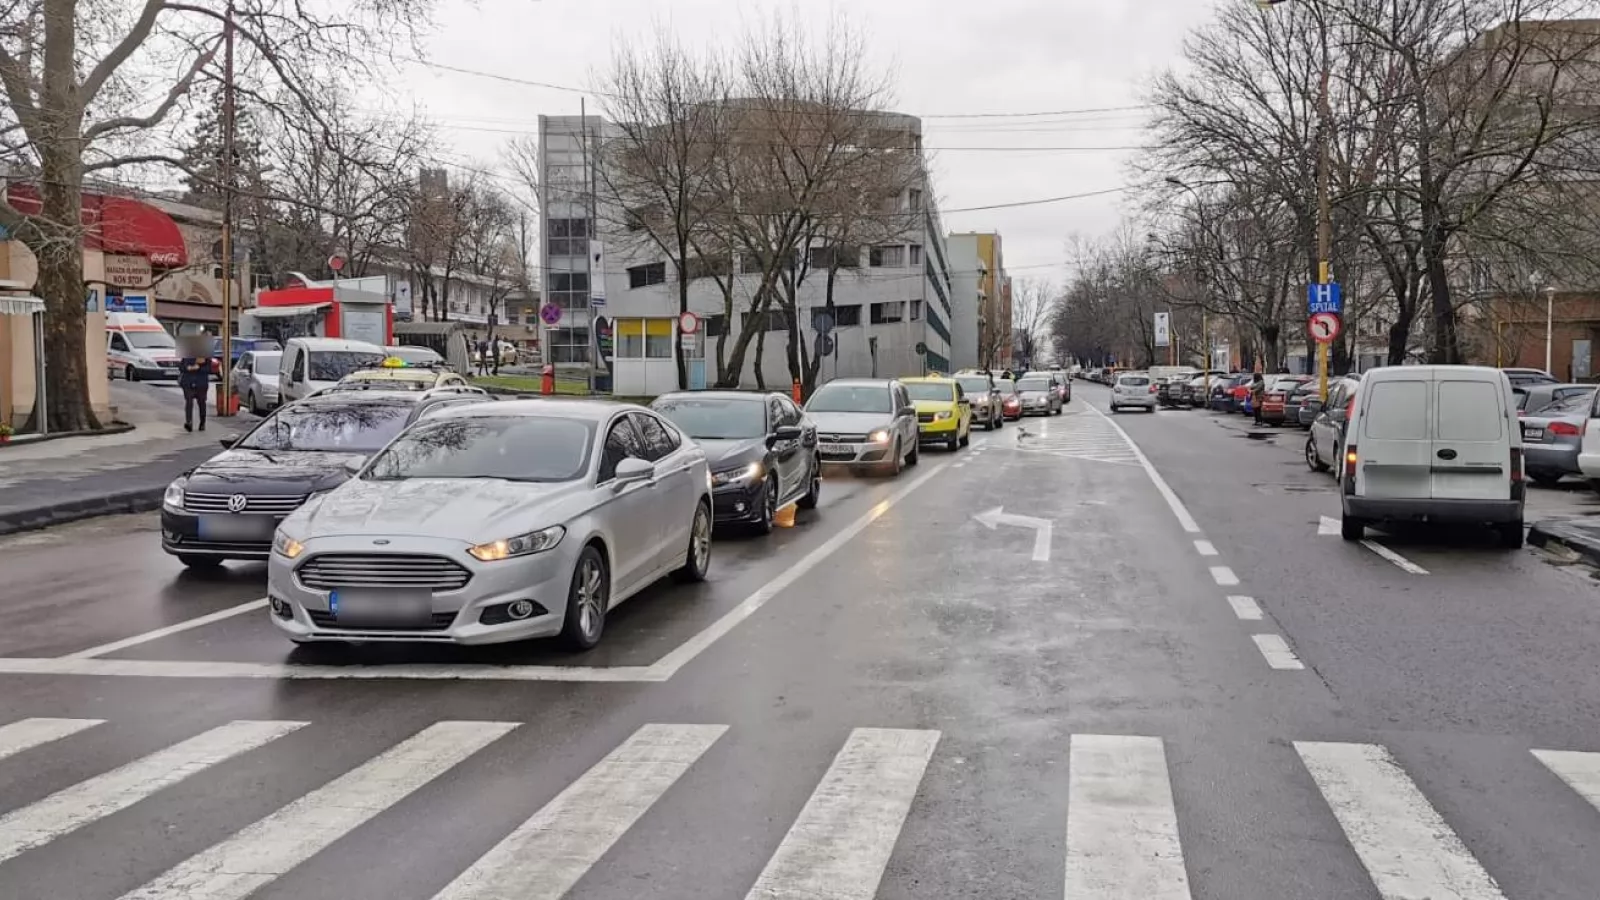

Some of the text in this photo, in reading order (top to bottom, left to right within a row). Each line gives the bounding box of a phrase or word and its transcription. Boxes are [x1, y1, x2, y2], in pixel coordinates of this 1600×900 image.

[113, 275, 143, 284] NON STOP
[1317, 284, 1331, 302] H
[1310, 302, 1339, 312] SPITAL
